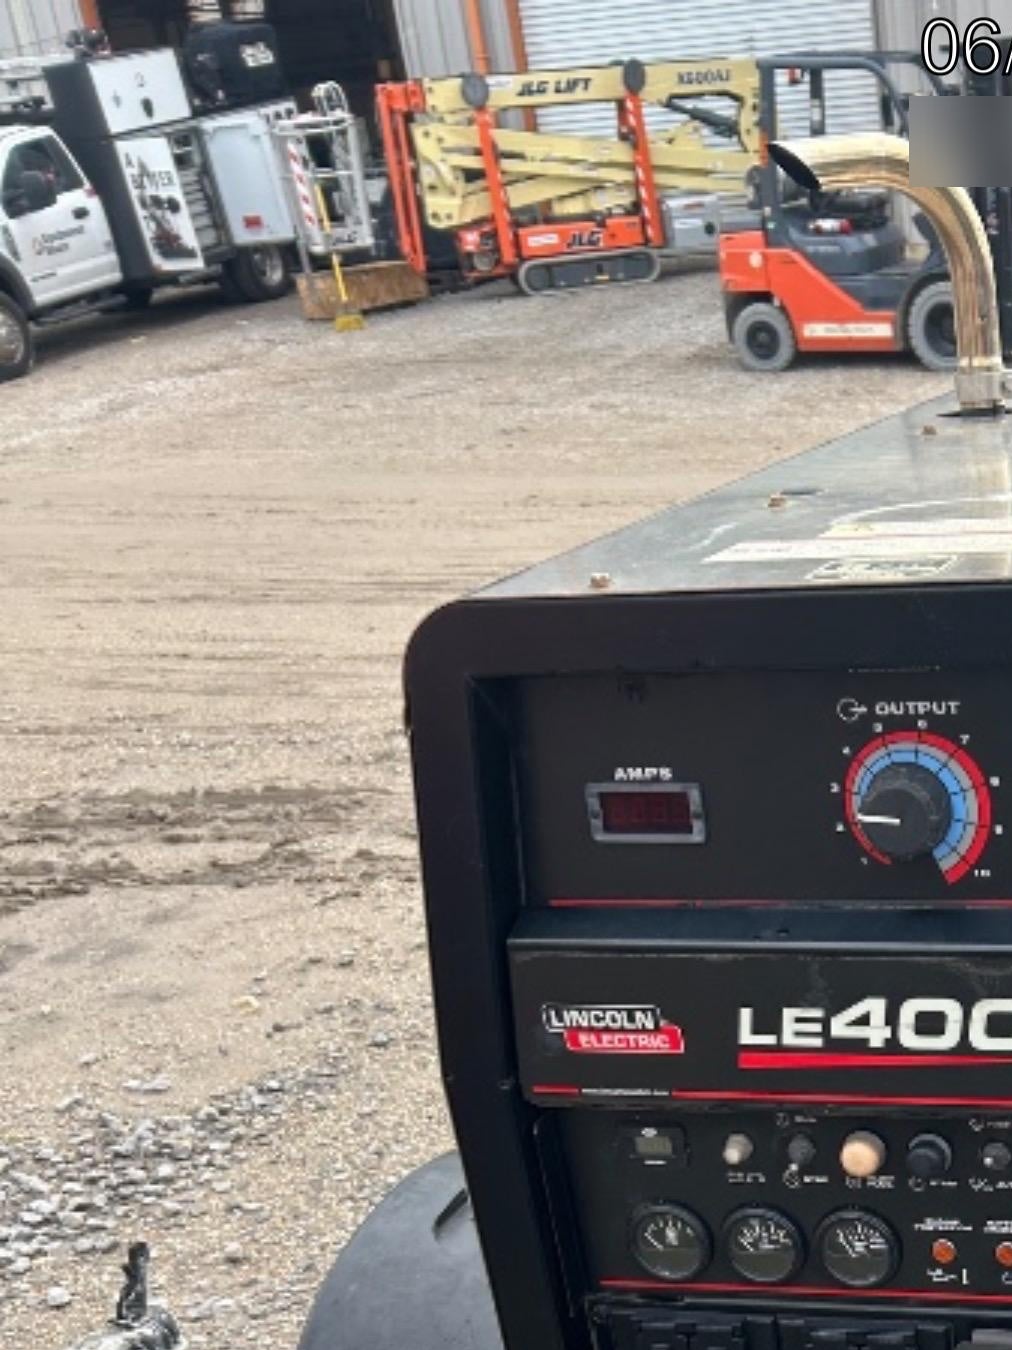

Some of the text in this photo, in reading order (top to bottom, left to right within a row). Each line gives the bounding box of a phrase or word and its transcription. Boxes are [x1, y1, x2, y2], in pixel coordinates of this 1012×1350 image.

[516, 76, 592, 97] JLG LIFT
[566, 231, 602, 249] JLG
[875, 701, 960, 716] OUTPUT
[614, 766, 673, 781] AMPS
[550, 1006, 654, 1030] LINCOLN
[578, 1031, 671, 1049] ELECTRIC
